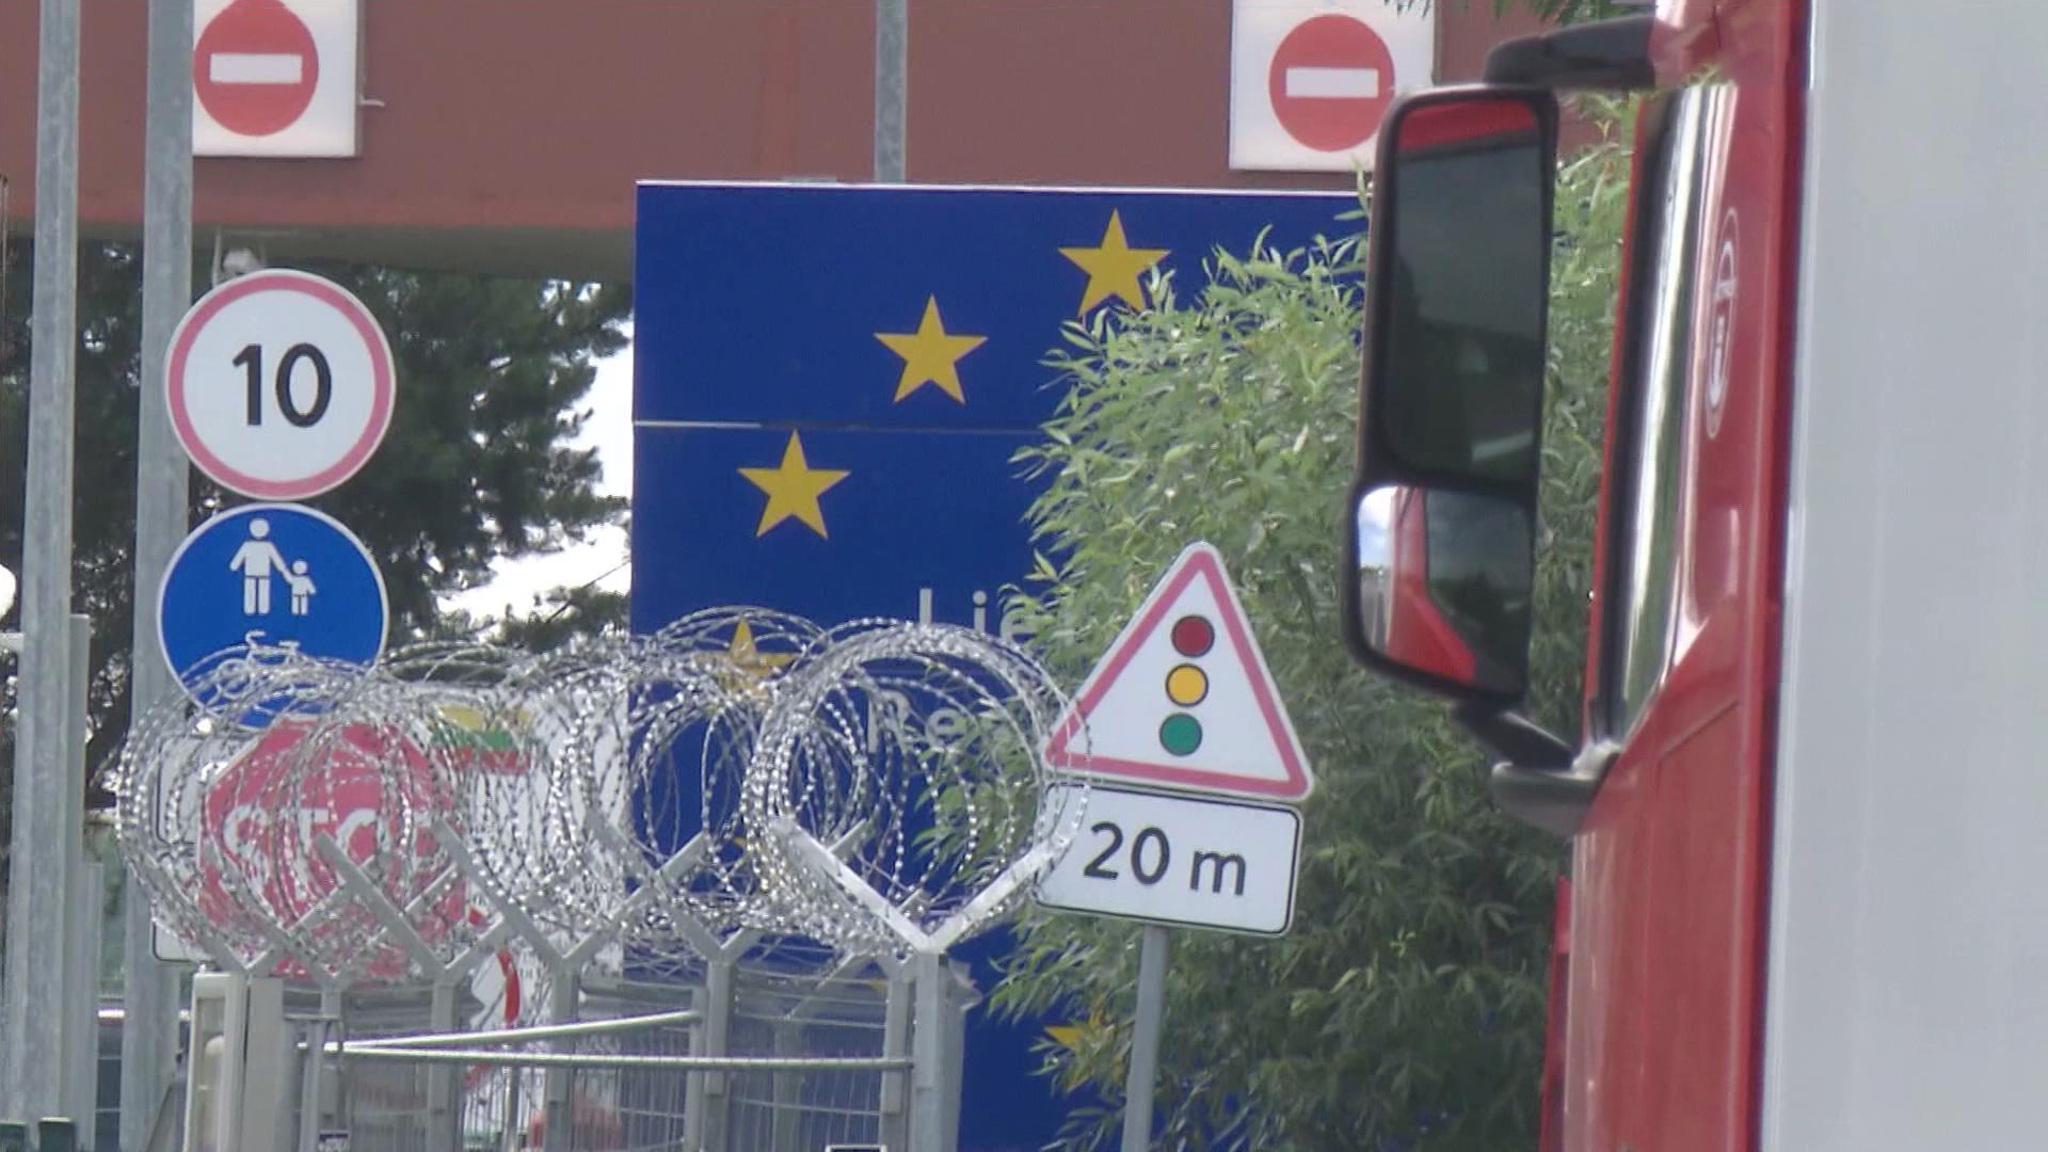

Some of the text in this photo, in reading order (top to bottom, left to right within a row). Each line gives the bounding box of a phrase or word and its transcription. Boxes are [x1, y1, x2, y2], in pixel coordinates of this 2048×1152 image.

[232, 342, 332, 428] 10
[1083, 821, 1247, 896] 20 m
